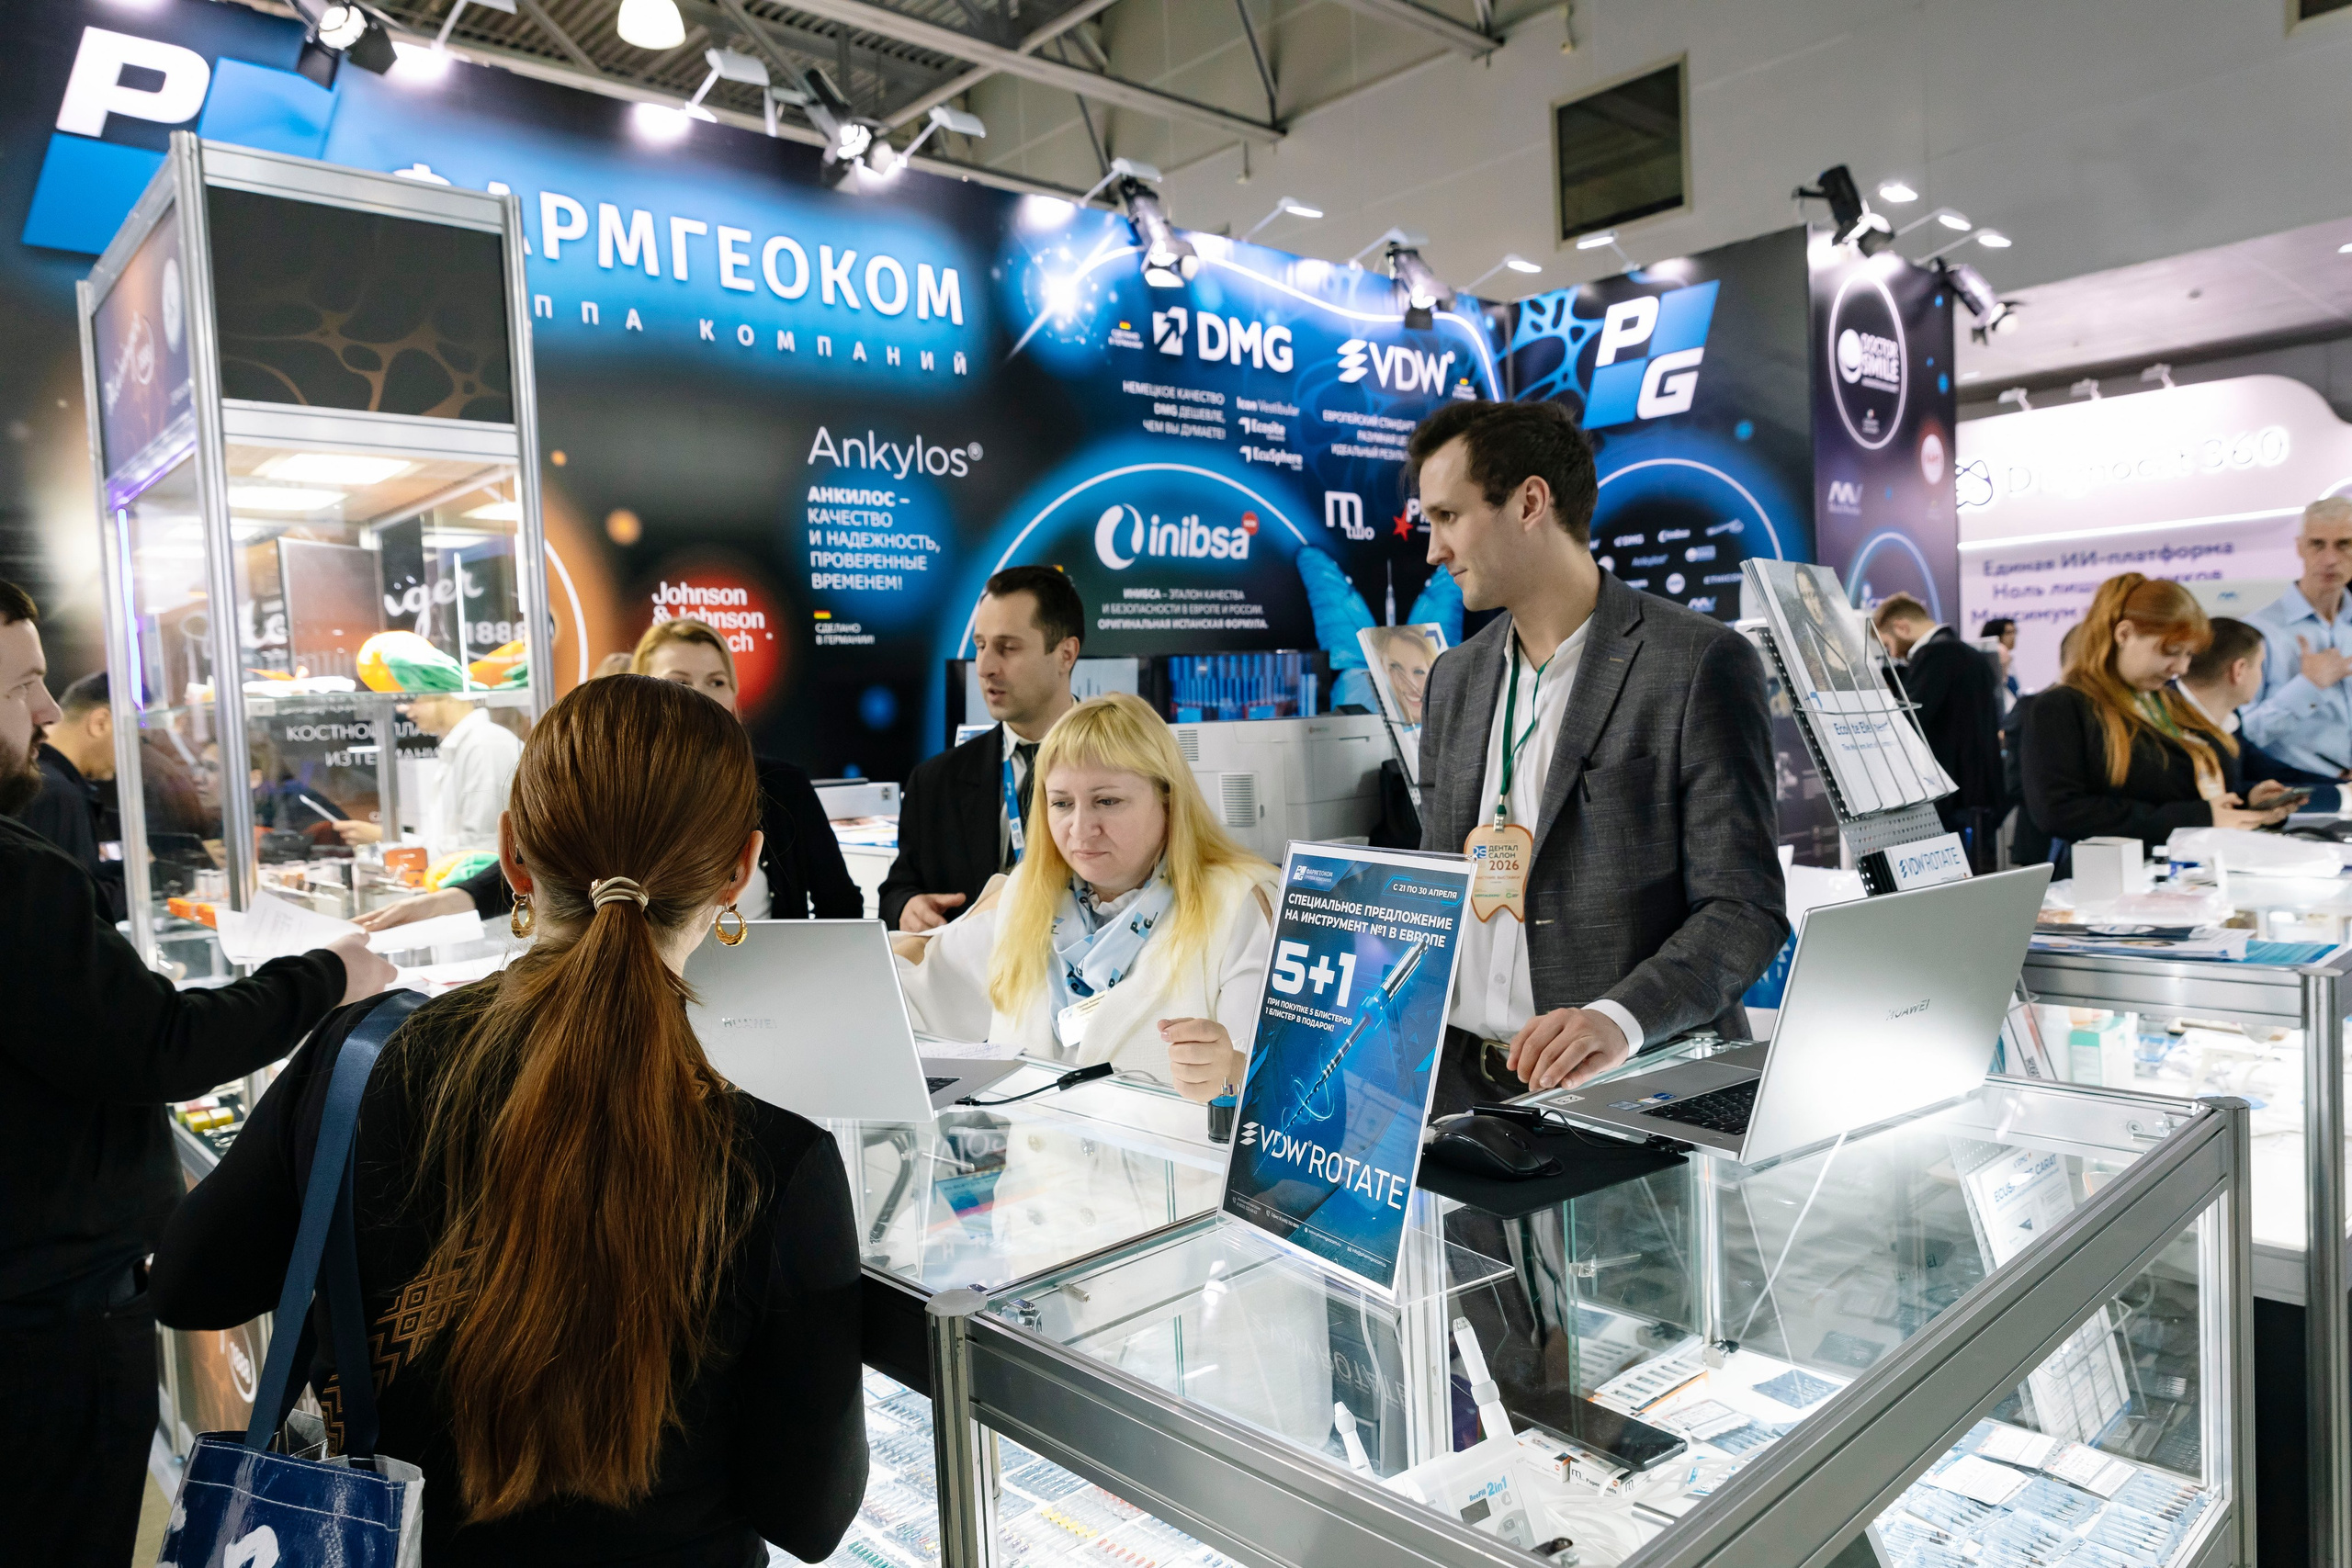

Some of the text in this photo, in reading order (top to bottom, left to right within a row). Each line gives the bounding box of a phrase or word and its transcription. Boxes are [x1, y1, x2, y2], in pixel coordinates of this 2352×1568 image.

[393, 164, 965, 326] РМГЕОКОМ
[699, 318, 967, 376] КОМПАНИЙ
[1197, 310, 1294, 373] DMG
[1123, 379, 1226, 405] НЕМЕЦКОЕ КАЧЕСТВО
[808, 486, 896, 507] АНКИЛОС
[808, 509, 893, 528] КАЧЕСТВО
[808, 530, 941, 554] И НАДЕЖНОСТЬ,
[1148, 513, 1250, 560] inibsa
[809, 551, 928, 571] ПРОВЕРЕННЫЕ
[1983, 558, 2055, 577] Единая
[651, 581, 748, 606] Johnson
[811, 572, 903, 591] ВРЕМЕНЕМ!
[1993, 582, 2044, 600] Ноль
[814, 622, 862, 634] СДЕЛАНО
[1489, 860, 1520, 870] 2026
[1392, 883, 1458, 899] С 21 ПО 30 АПРЕЛЯ
[1288, 892, 1453, 931] СПЕЦИАЛЬНОЕ ПРЕДЛОЖЕНИЕ
[1284, 908, 1447, 949] НА ИНСТРУМЕНТ №1 В ЕВРОПЕ
[1272, 939, 1358, 1009] 5+1
[1267, 997, 1353, 1027] ПРИ ПОКУПКЕ 5 БЛИСТЕРОВ
[1268, 1008, 1296, 1022] БЛИСТЕР
[1295, 1013, 1301, 1022] В
[1301, 1015, 1335, 1032] ПОДАРОК!
[1886, 998, 1930, 1021] HUAWEI
[1468, 1474, 1508, 1502] BeeFill 2in1
[1585, 1477, 1600, 1488] Paper
